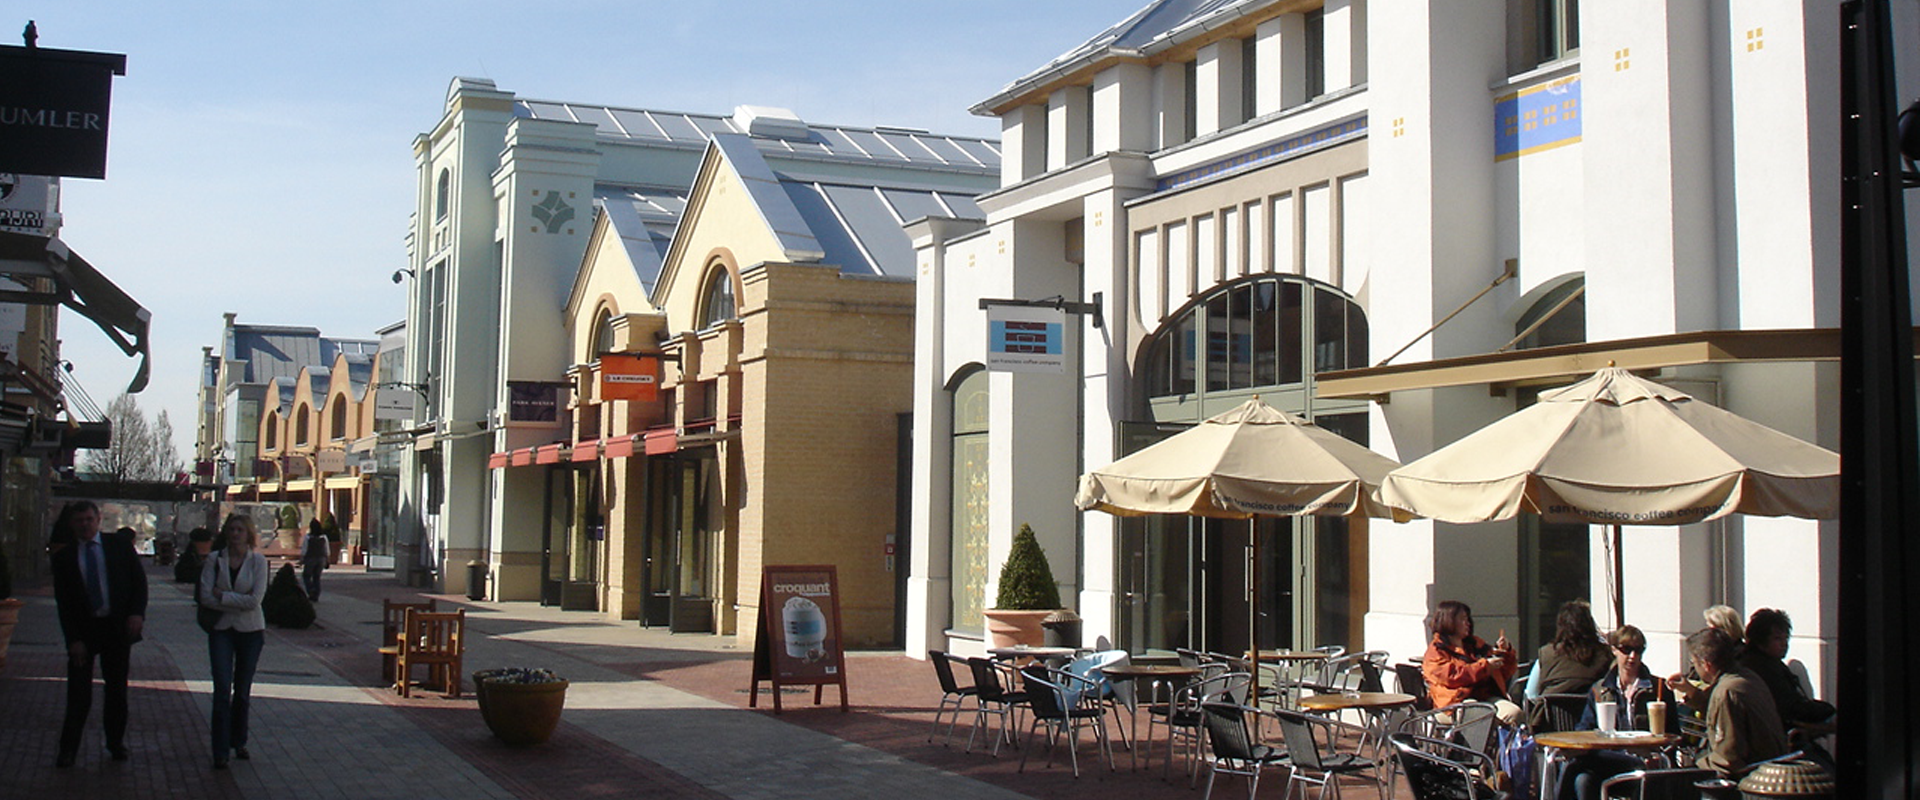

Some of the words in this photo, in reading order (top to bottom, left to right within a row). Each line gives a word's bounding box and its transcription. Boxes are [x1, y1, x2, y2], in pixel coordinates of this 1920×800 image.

[1550, 505, 1569, 514] san
[1633, 508, 1674, 520] coffee
[1677, 502, 1730, 518] compa
[773, 582, 831, 595] croquant
